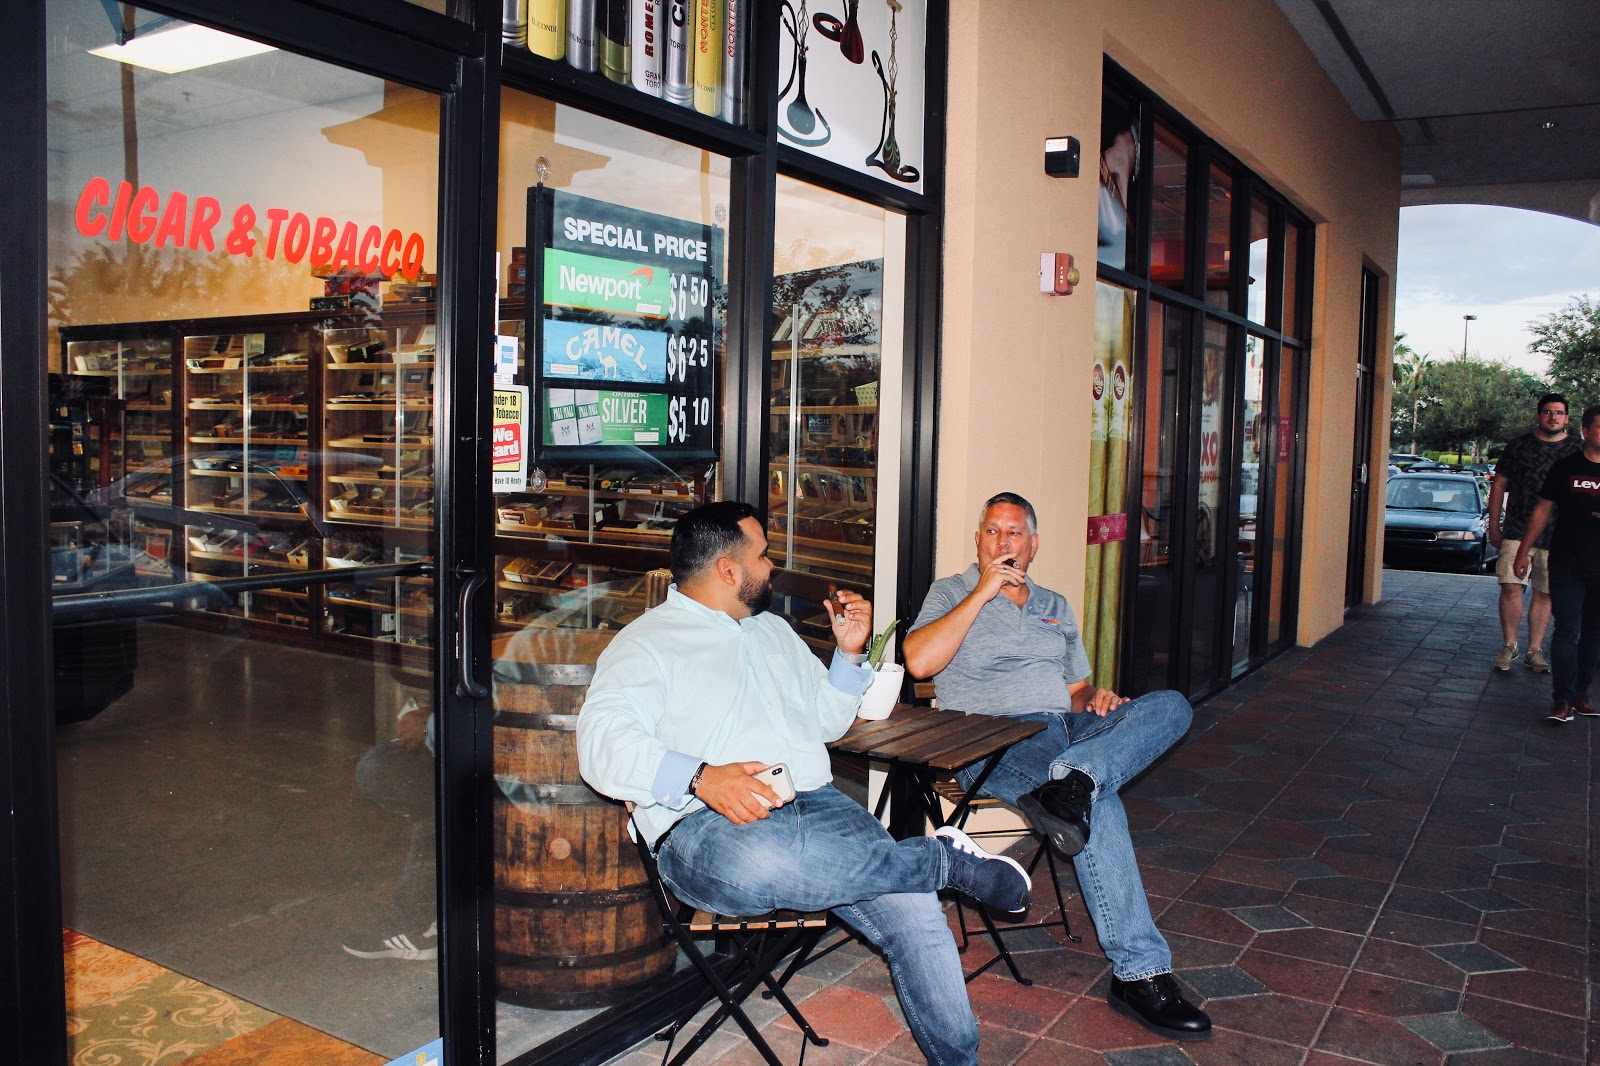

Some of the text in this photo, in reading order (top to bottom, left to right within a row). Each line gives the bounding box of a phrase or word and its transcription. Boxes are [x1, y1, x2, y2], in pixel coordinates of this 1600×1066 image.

[645, 0, 654, 57] ROME
[669, 38, 686, 52] TORO
[727, 0, 736, 57] MONTE
[75, 177, 424, 280] CIGAR & TOBACCO
[563, 216, 708, 262] SPECIAL PRICE
[559, 265, 642, 301] Newport
[566, 326, 648, 372] CAMEL
[496, 408, 520, 420] Tobacco
[510, 395, 517, 406] 18
[602, 397, 648, 424] SILVER
[493, 427, 514, 442] We
